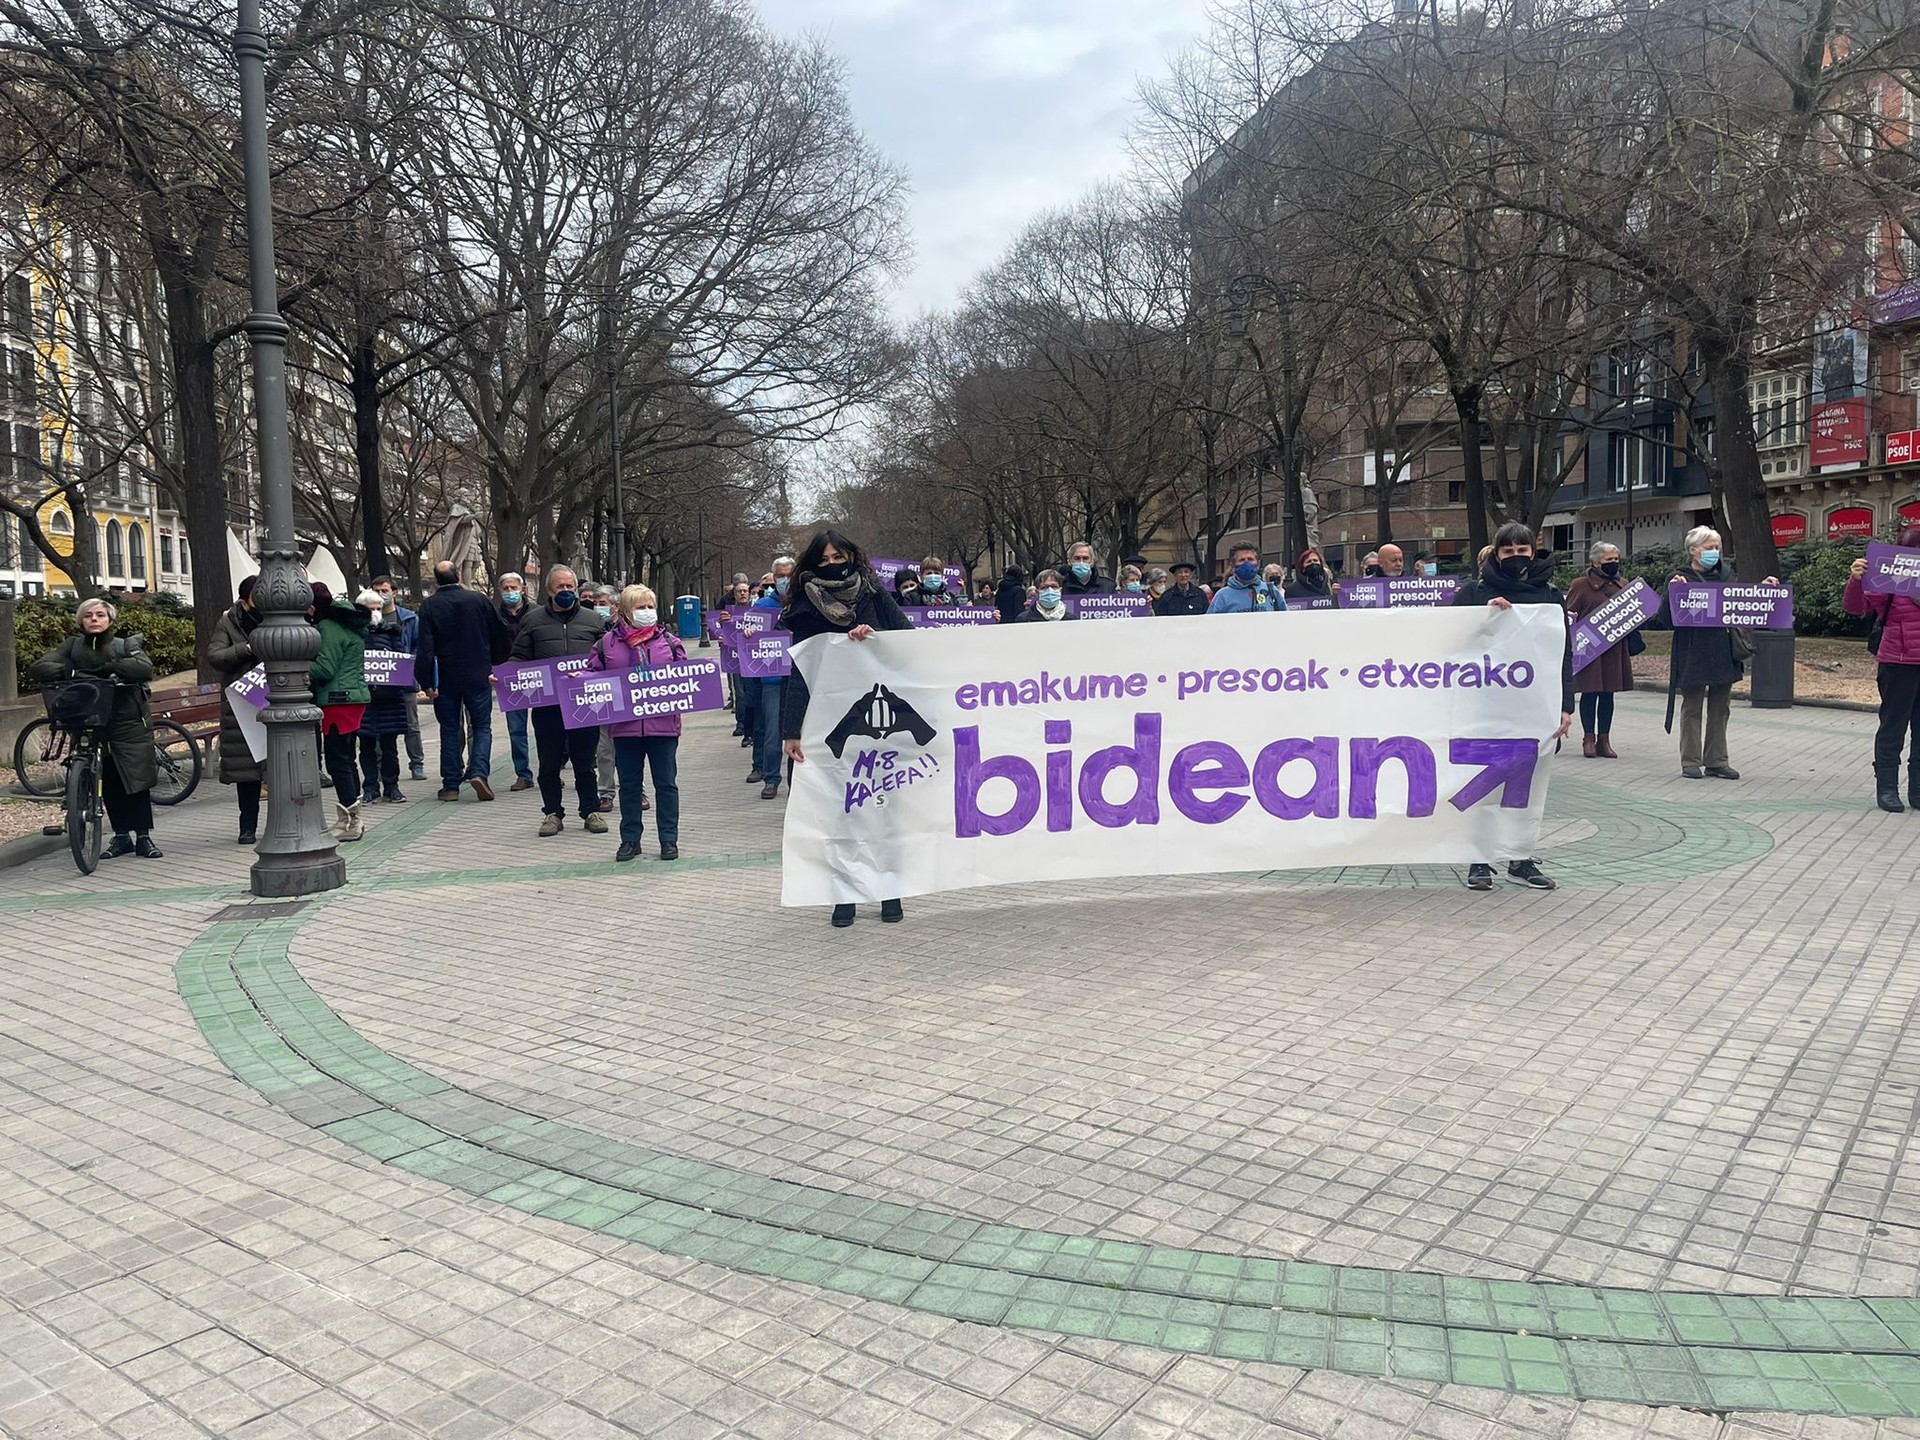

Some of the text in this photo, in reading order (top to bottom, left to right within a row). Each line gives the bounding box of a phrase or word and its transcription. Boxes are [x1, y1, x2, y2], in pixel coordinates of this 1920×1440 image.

[1888, 438, 1900, 446] PSN
[1887, 445, 1910, 458] PSOE
[1775, 526, 1804, 536] Santander
[1839, 520, 1871, 531] Santander
[1880, 563, 1920, 578] bidea
[1356, 584, 1376, 593] izan
[1389, 577, 1456, 590] emakume
[1350, 592, 1377, 601] bidea
[1389, 589, 1443, 604] presoak
[1688, 589, 1709, 600] izan
[1723, 585, 1789, 598] emakume
[1079, 595, 1147, 607] emakume
[1589, 581, 1644, 624] emakume
[1679, 598, 1709, 609] bidea
[1722, 600, 1775, 613] presoak
[743, 613, 764, 623] izan
[927, 607, 993, 619] emakume
[1079, 607, 1133, 620] presoak
[1597, 598, 1643, 636] presoak
[1722, 613, 1768, 625] etxera!
[735, 621, 763, 632] bidea
[1606, 609, 1646, 643] etxera!
[759, 639, 782, 649] izan
[751, 649, 782, 659] bidea
[516, 670, 542, 681] izan
[628, 661, 716, 684] emakume
[510, 677, 544, 692] bidea
[583, 681, 612, 693] izan
[954, 654, 1536, 710] emakume presoak etxerako
[575, 690, 613, 706] bidea
[630, 680, 701, 704] presoak
[632, 694, 694, 717] etxera!
[952, 712, 1437, 839] bidean
[844, 752, 941, 814] KALERA!!
